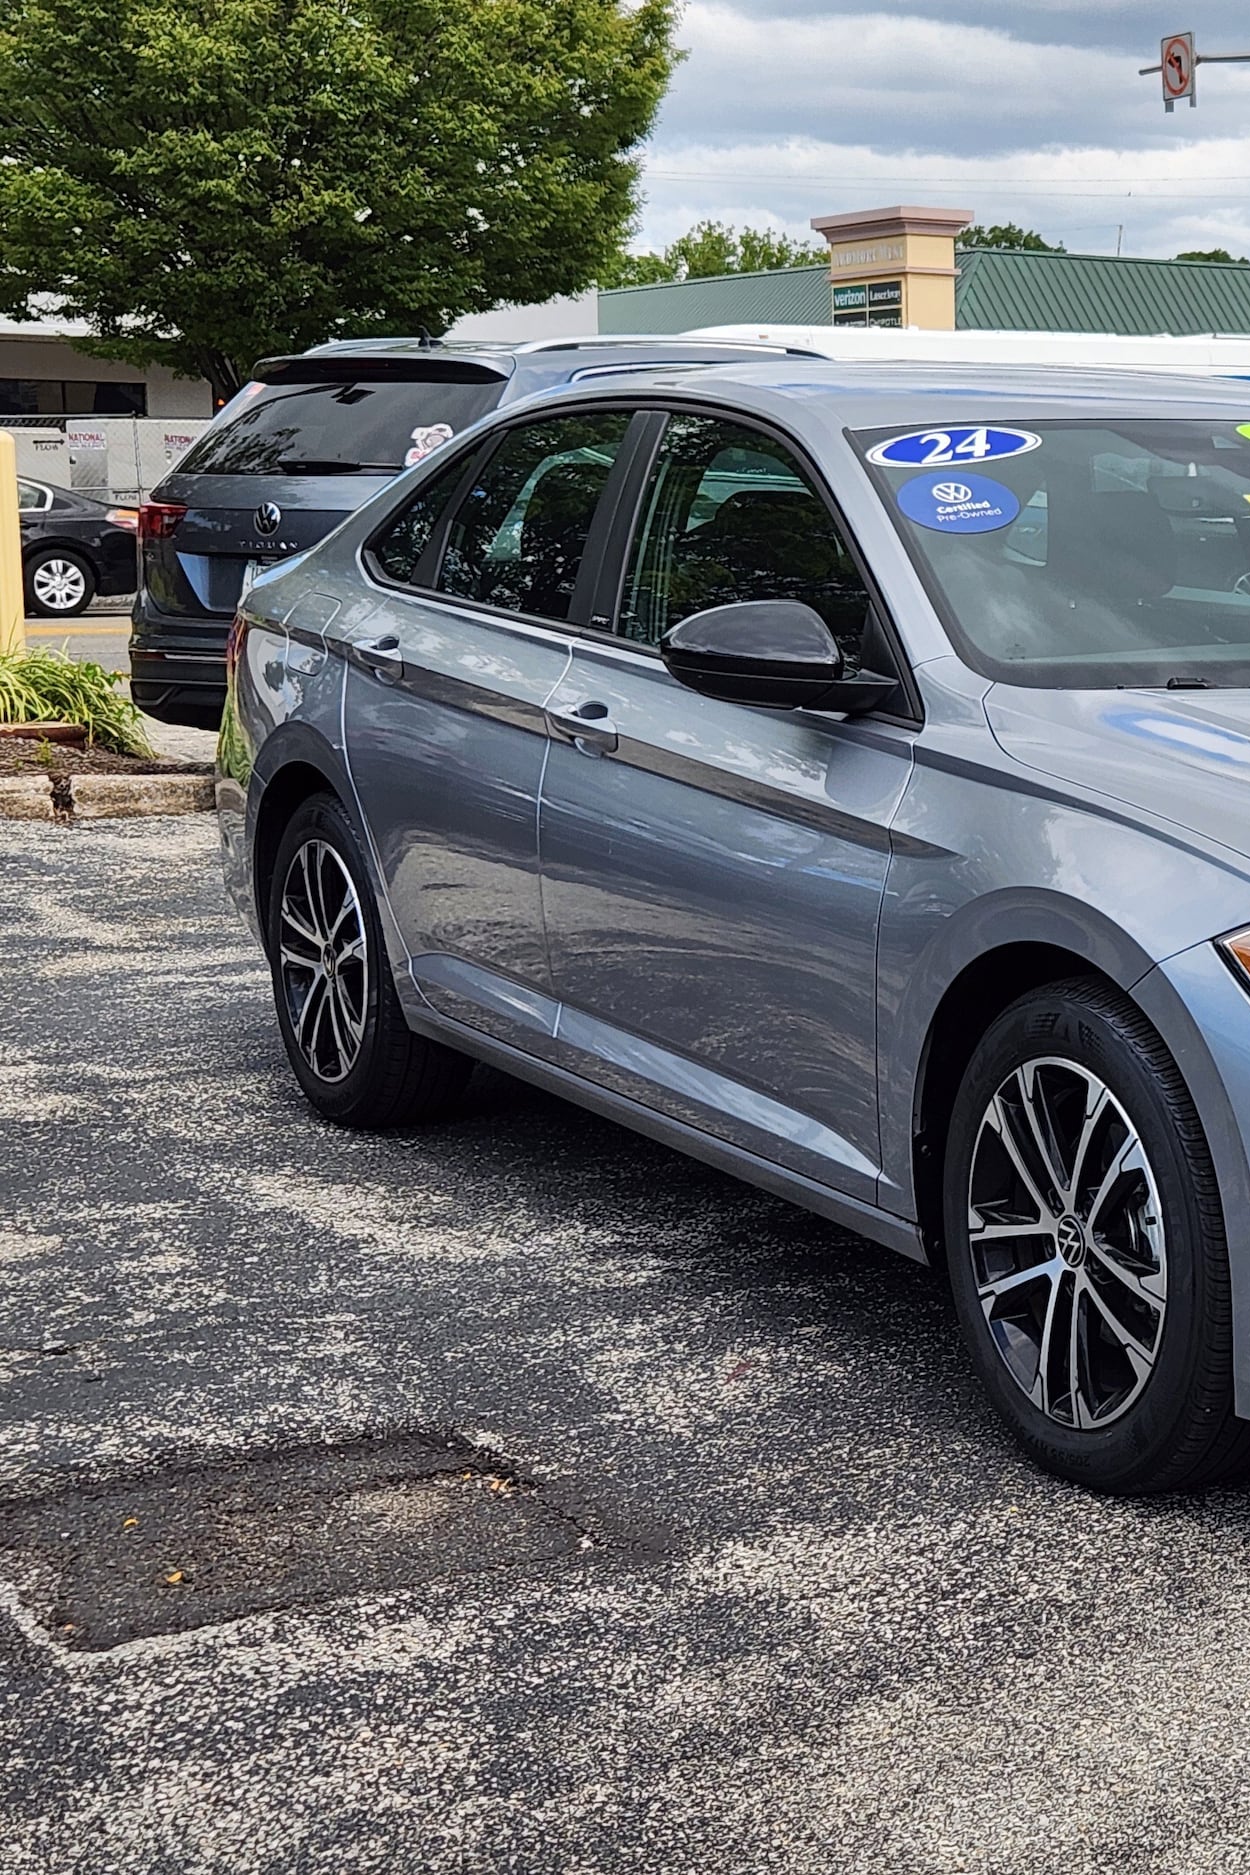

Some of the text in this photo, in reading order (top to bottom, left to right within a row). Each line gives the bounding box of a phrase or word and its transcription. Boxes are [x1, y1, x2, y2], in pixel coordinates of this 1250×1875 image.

[834, 289, 866, 307] verizon
[919, 429, 991, 464] 24
[936, 500, 991, 514] Certified
[936, 508, 1002, 522] Pre-Owned
